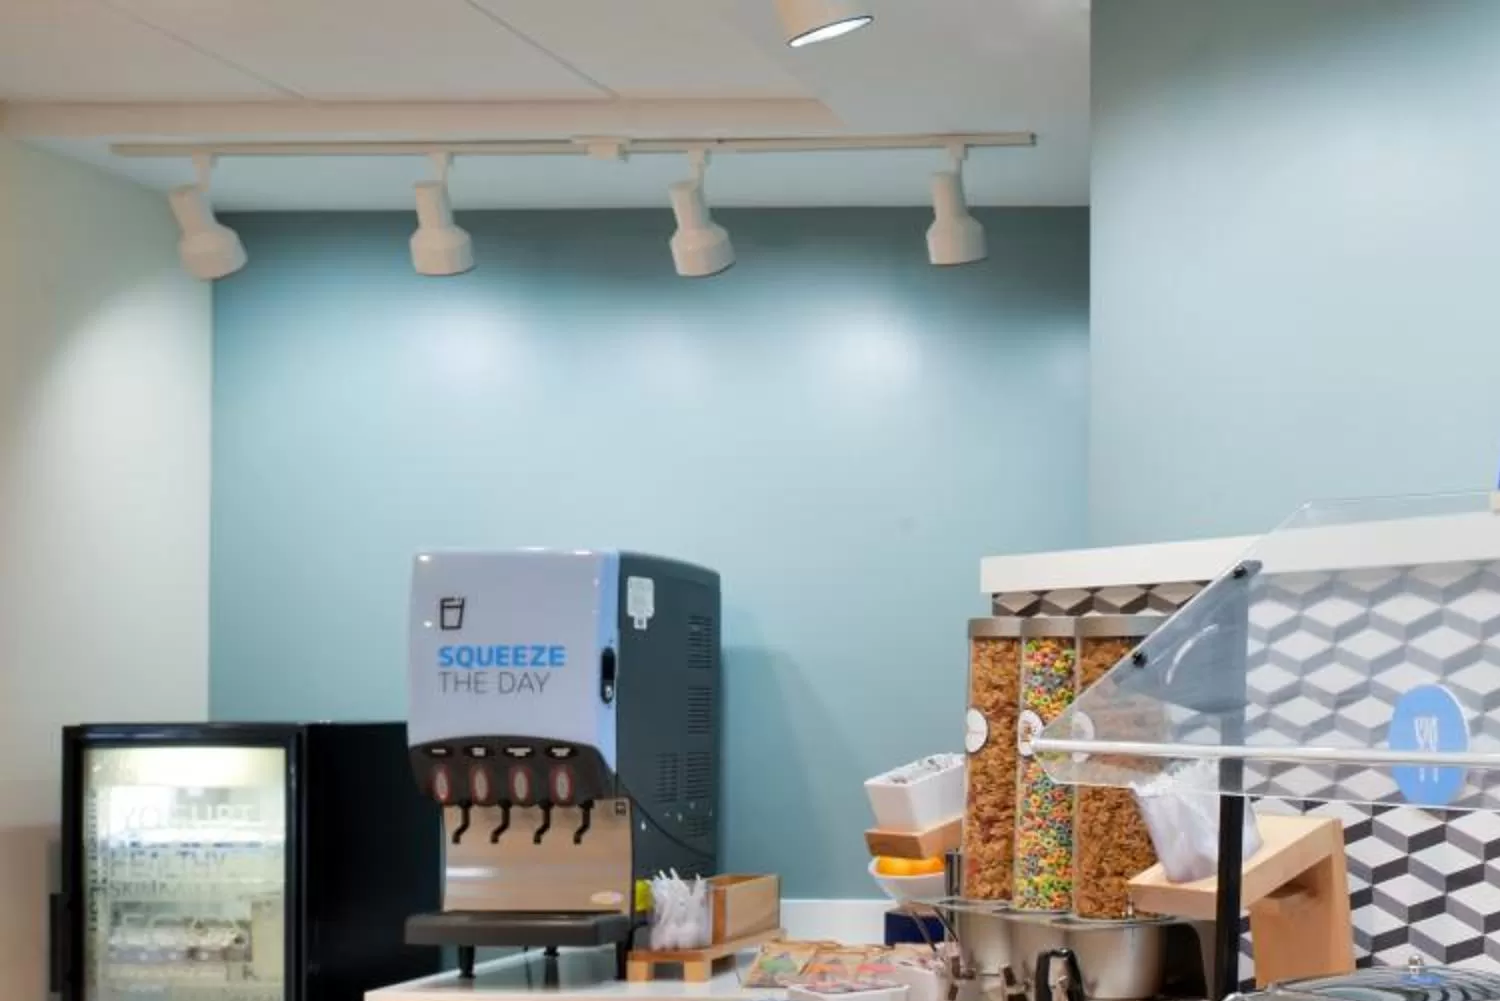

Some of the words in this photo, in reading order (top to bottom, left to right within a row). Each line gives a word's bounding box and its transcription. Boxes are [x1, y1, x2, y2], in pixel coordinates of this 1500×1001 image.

[437, 645, 566, 668] SQUEEZE
[438, 671, 488, 693] THE
[497, 671, 552, 693] DAY
